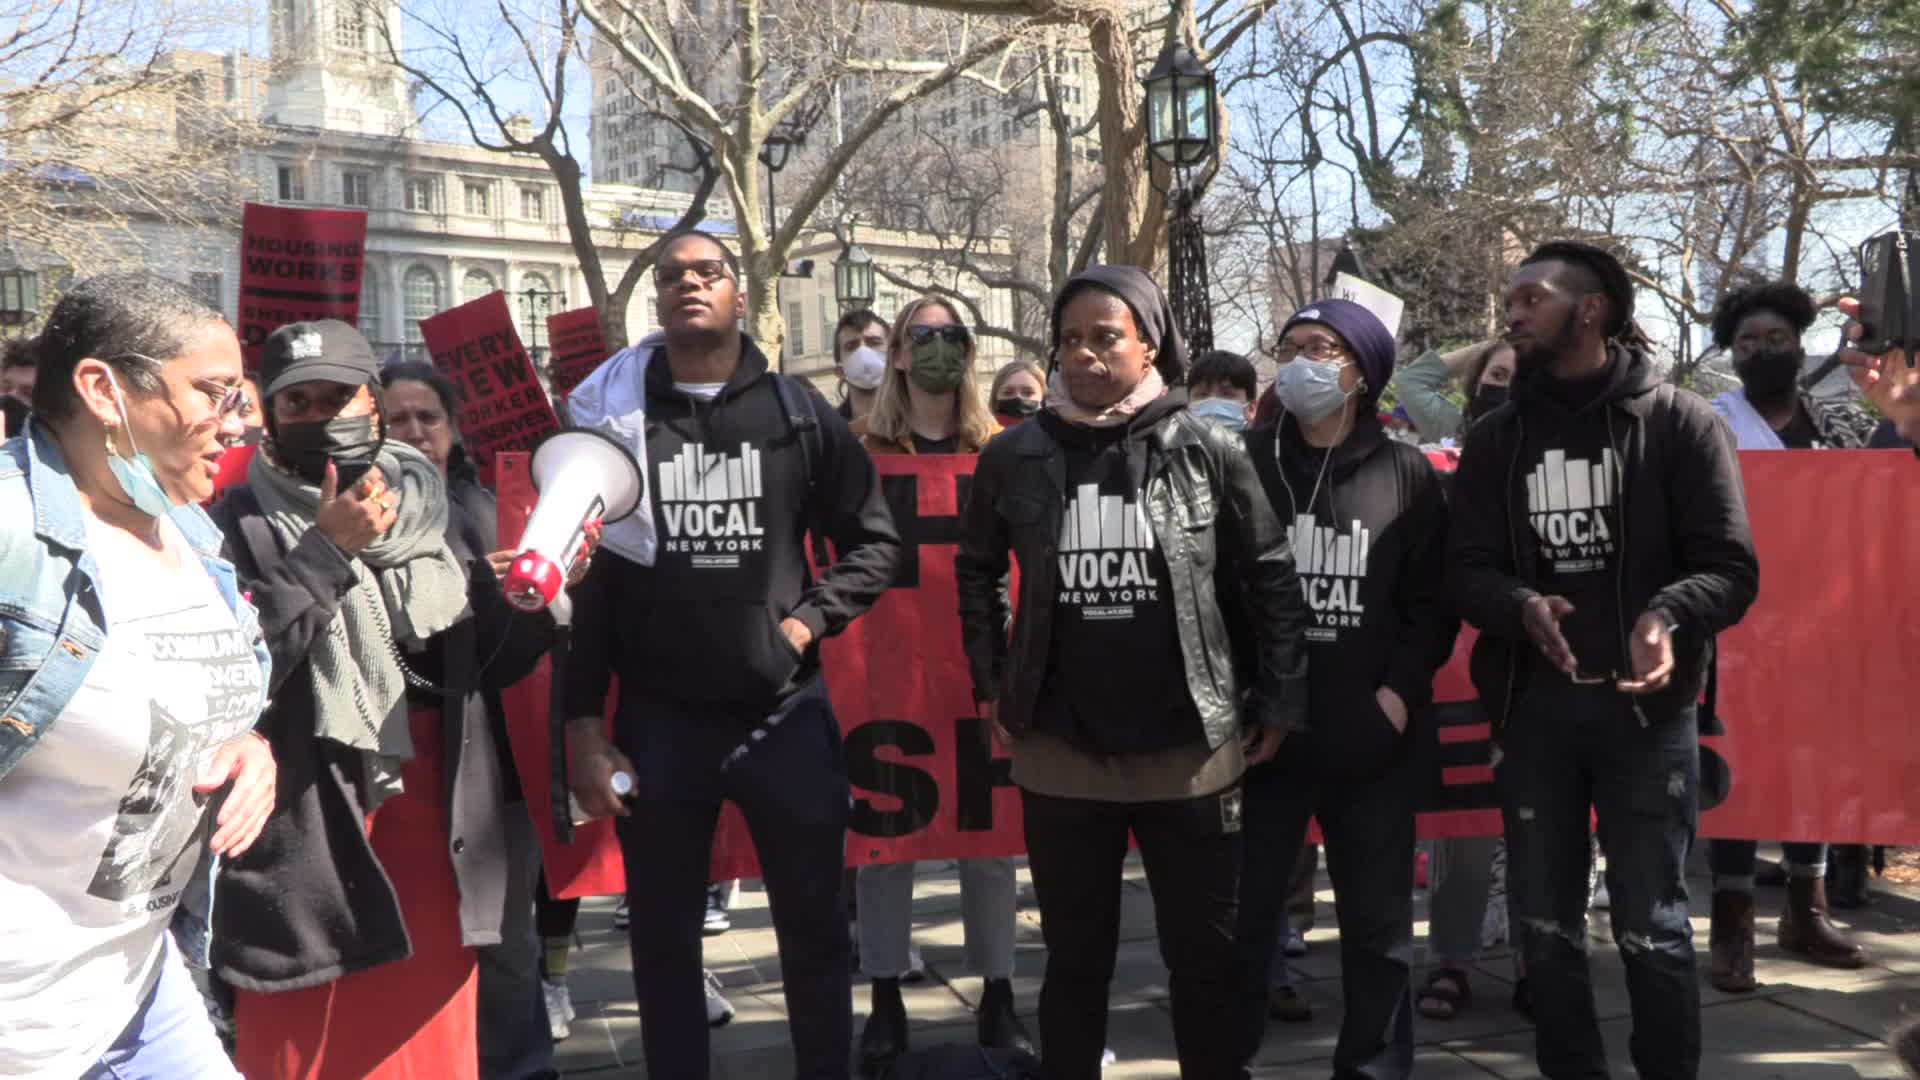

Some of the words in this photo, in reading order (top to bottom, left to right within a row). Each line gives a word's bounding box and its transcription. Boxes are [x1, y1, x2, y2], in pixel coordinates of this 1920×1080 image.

[247, 233, 360, 258] HOUSING
[246, 255, 357, 282] WORKS
[434, 330, 514, 369] EVERY
[464, 386, 541, 427] ORKER
[661, 501, 764, 537] VOCAL
[667, 540, 707, 552] NEW
[715, 538, 763, 551] YORK
[1058, 551, 1158, 589] VOCAL
[1059, 591, 1100, 603] NEW
[1109, 589, 1159, 602] YORK
[1315, 613, 1361, 627] YORK
